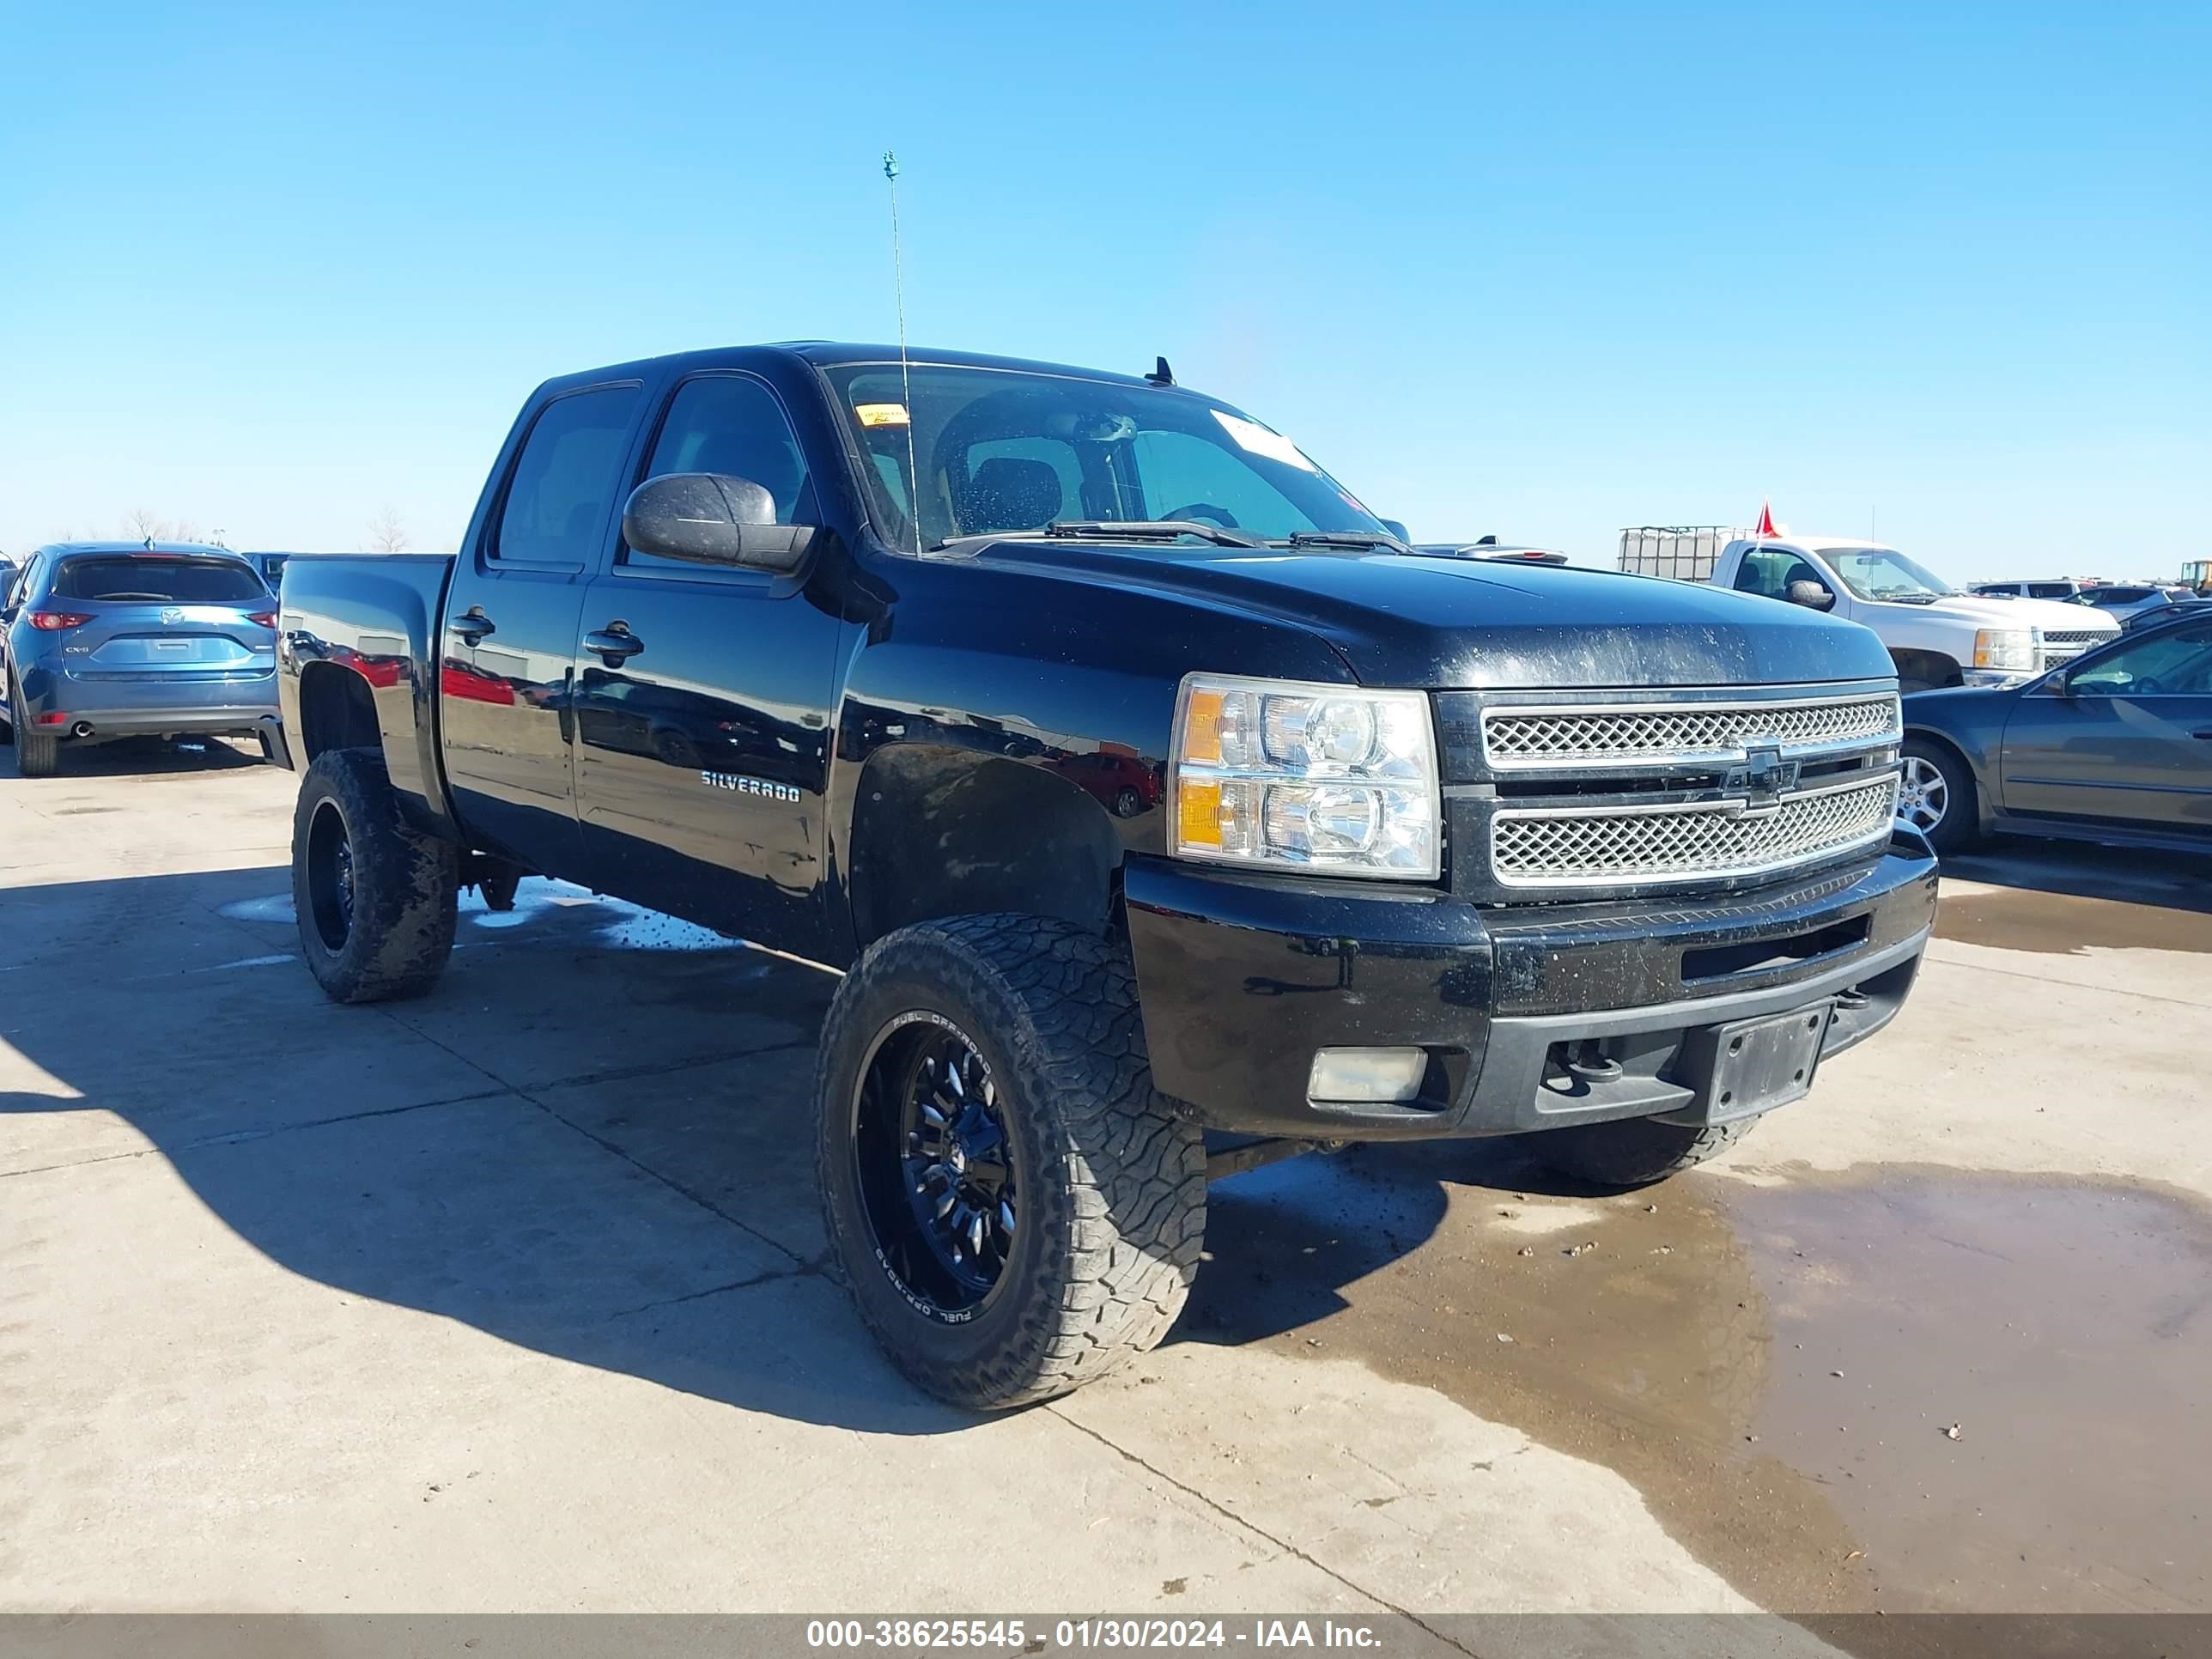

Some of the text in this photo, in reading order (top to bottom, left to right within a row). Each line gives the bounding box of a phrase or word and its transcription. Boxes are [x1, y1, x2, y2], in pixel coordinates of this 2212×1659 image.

[701, 770, 801, 803] SILVERADO
[893, 1013, 992, 1075] FUEL OFF-ROAD
[940, 1310, 972, 1322] FUEL
